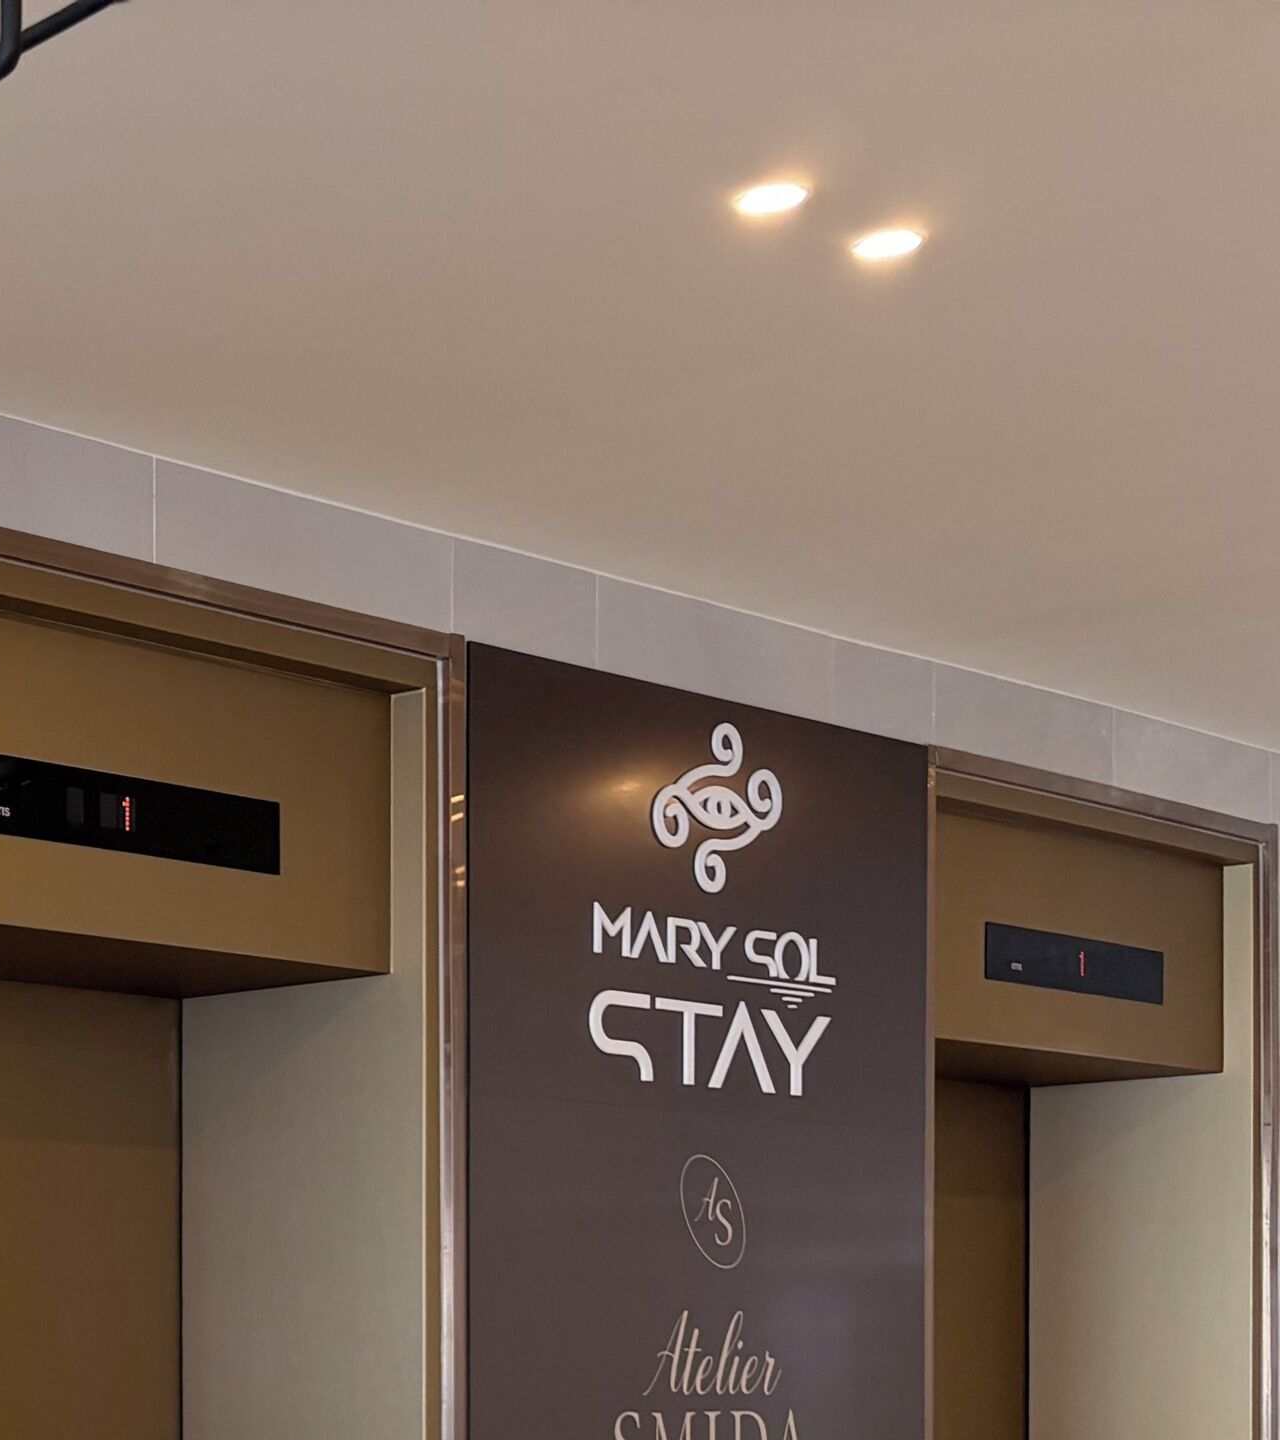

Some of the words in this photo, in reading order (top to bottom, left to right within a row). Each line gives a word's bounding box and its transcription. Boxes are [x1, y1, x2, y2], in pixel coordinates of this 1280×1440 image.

[121, 796, 131, 832] 1
[592, 900, 738, 971] MARY
[744, 929, 837, 986] SOL
[588, 989, 832, 1097] STAY
[642, 1309, 783, 1396] Atelier
